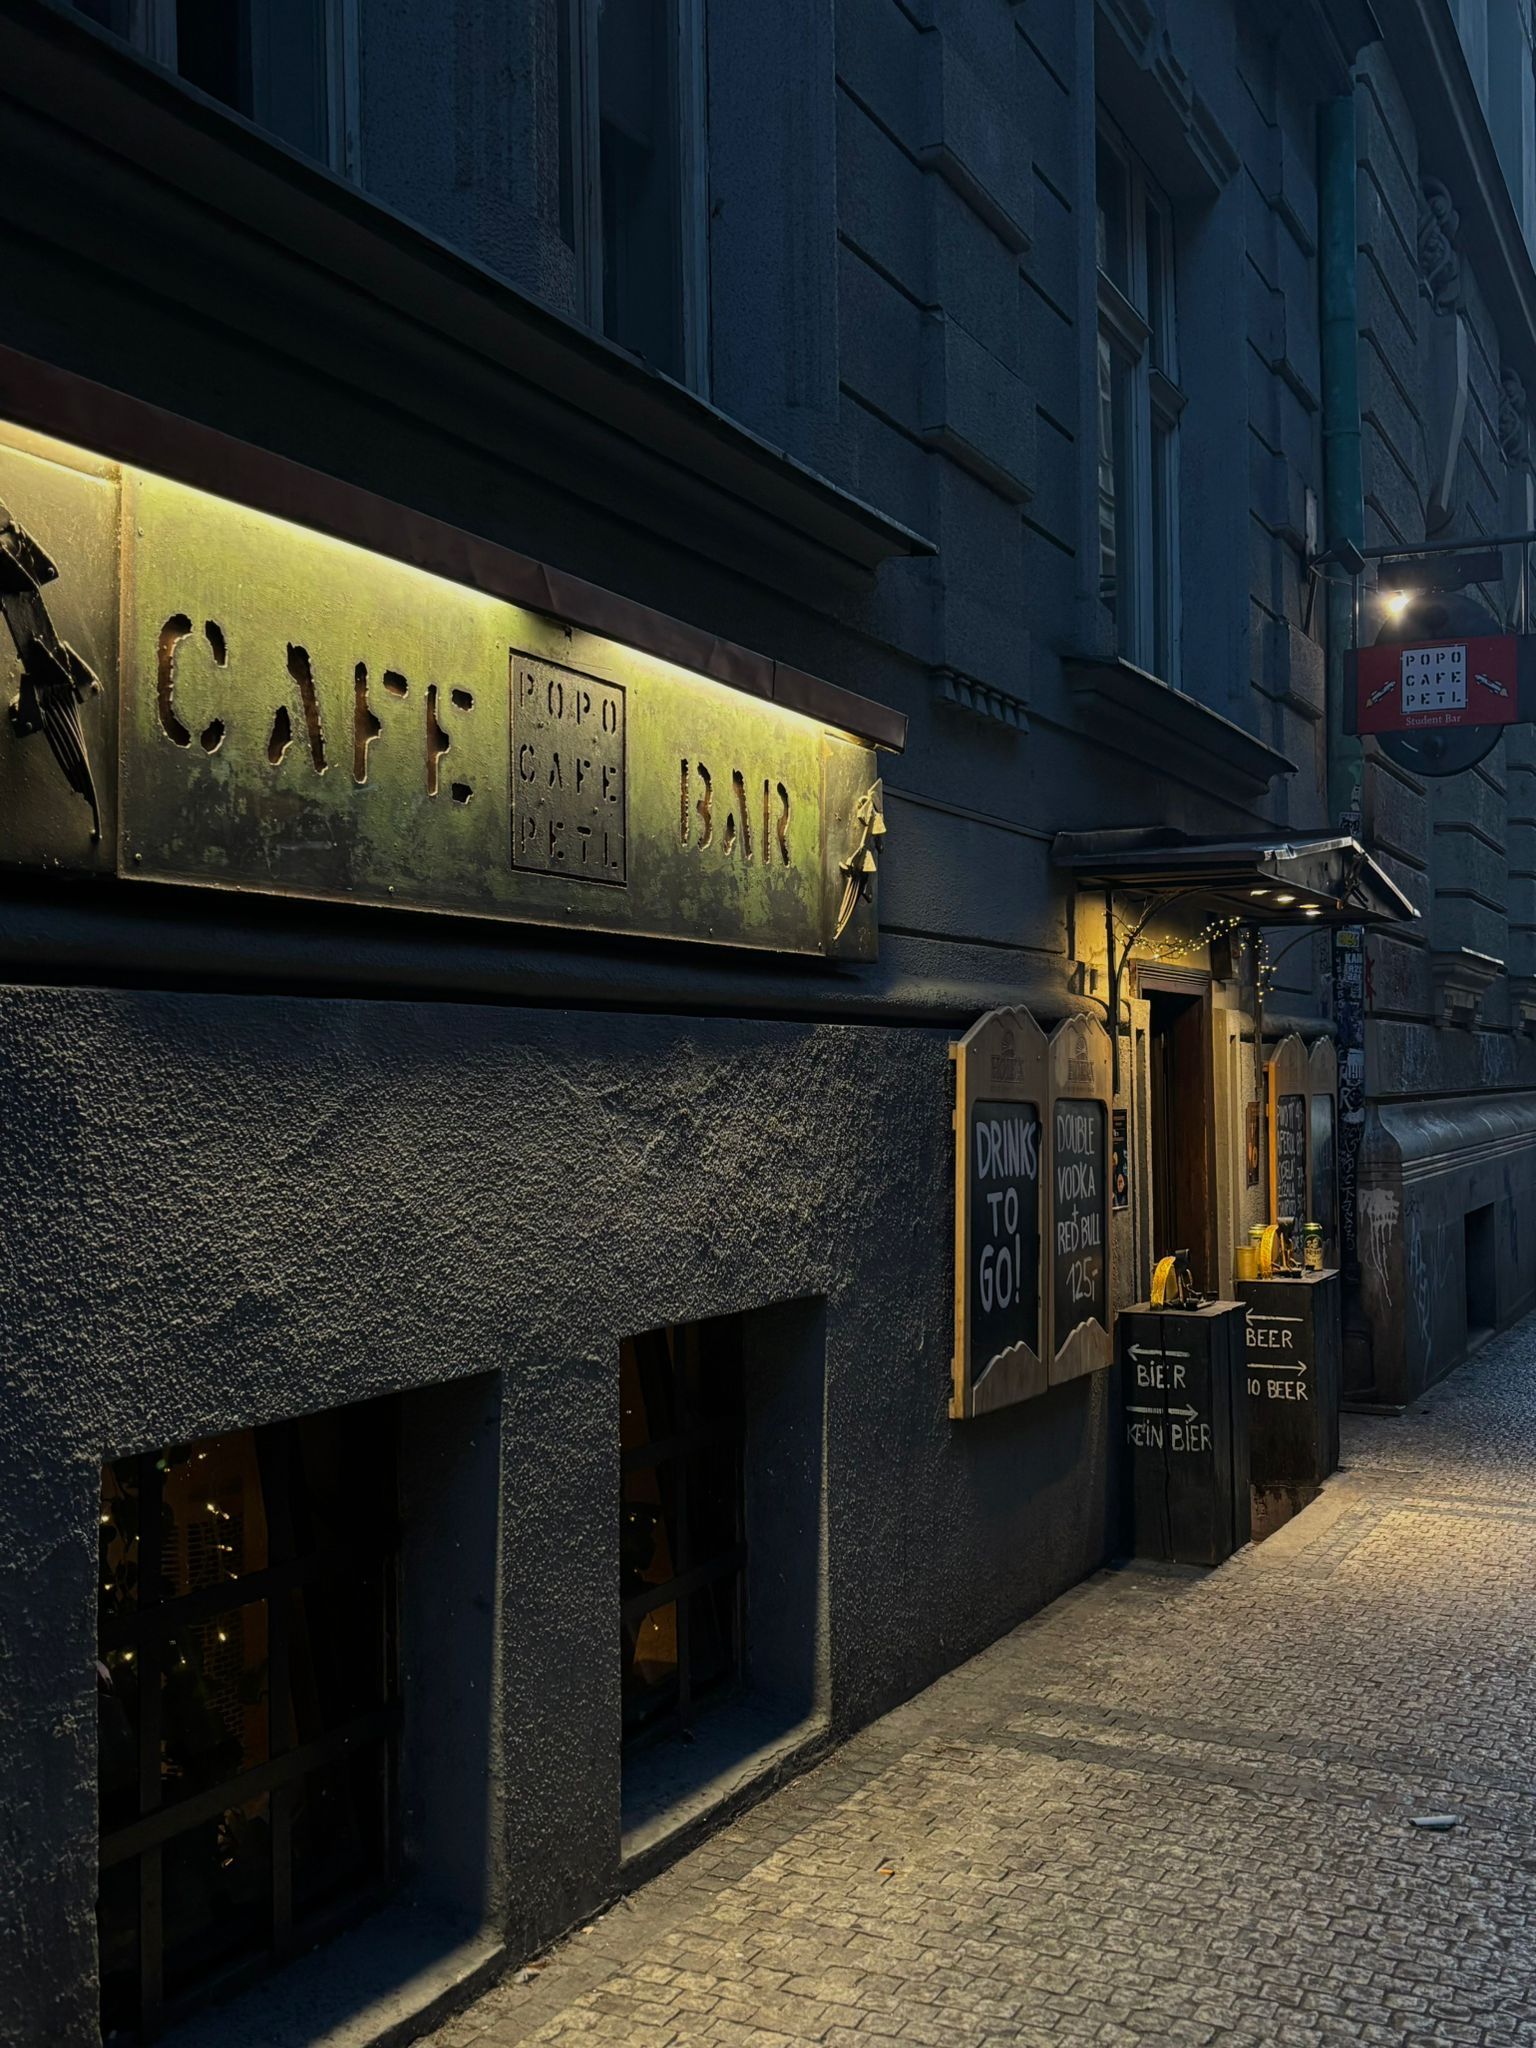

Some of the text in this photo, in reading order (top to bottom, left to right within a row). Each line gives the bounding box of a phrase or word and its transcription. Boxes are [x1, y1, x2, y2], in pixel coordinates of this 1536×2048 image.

[1406, 651, 1461, 667] POPO
[1406, 671, 1461, 687] CAFE
[519, 671, 617, 735] POPO
[1406, 691, 1461, 706] PETL
[1406, 713, 1462, 726] Student Bar
[156, 613, 791, 869] CAFE BAR
[519, 743, 617, 803] CAFE
[520, 815, 618, 869] PETL
[975, 1118, 1037, 1181] DRINKS
[1056, 1114, 1095, 1156] DOUBLE
[1057, 1161, 1096, 1204] VODKA
[986, 1187, 1019, 1237] TO
[1057, 1213, 1101, 1256] RED BULL
[979, 1232, 1022, 1313] GO!
[1245, 1328, 1293, 1349] BEER
[1267, 1379, 1309, 1401] BEER
